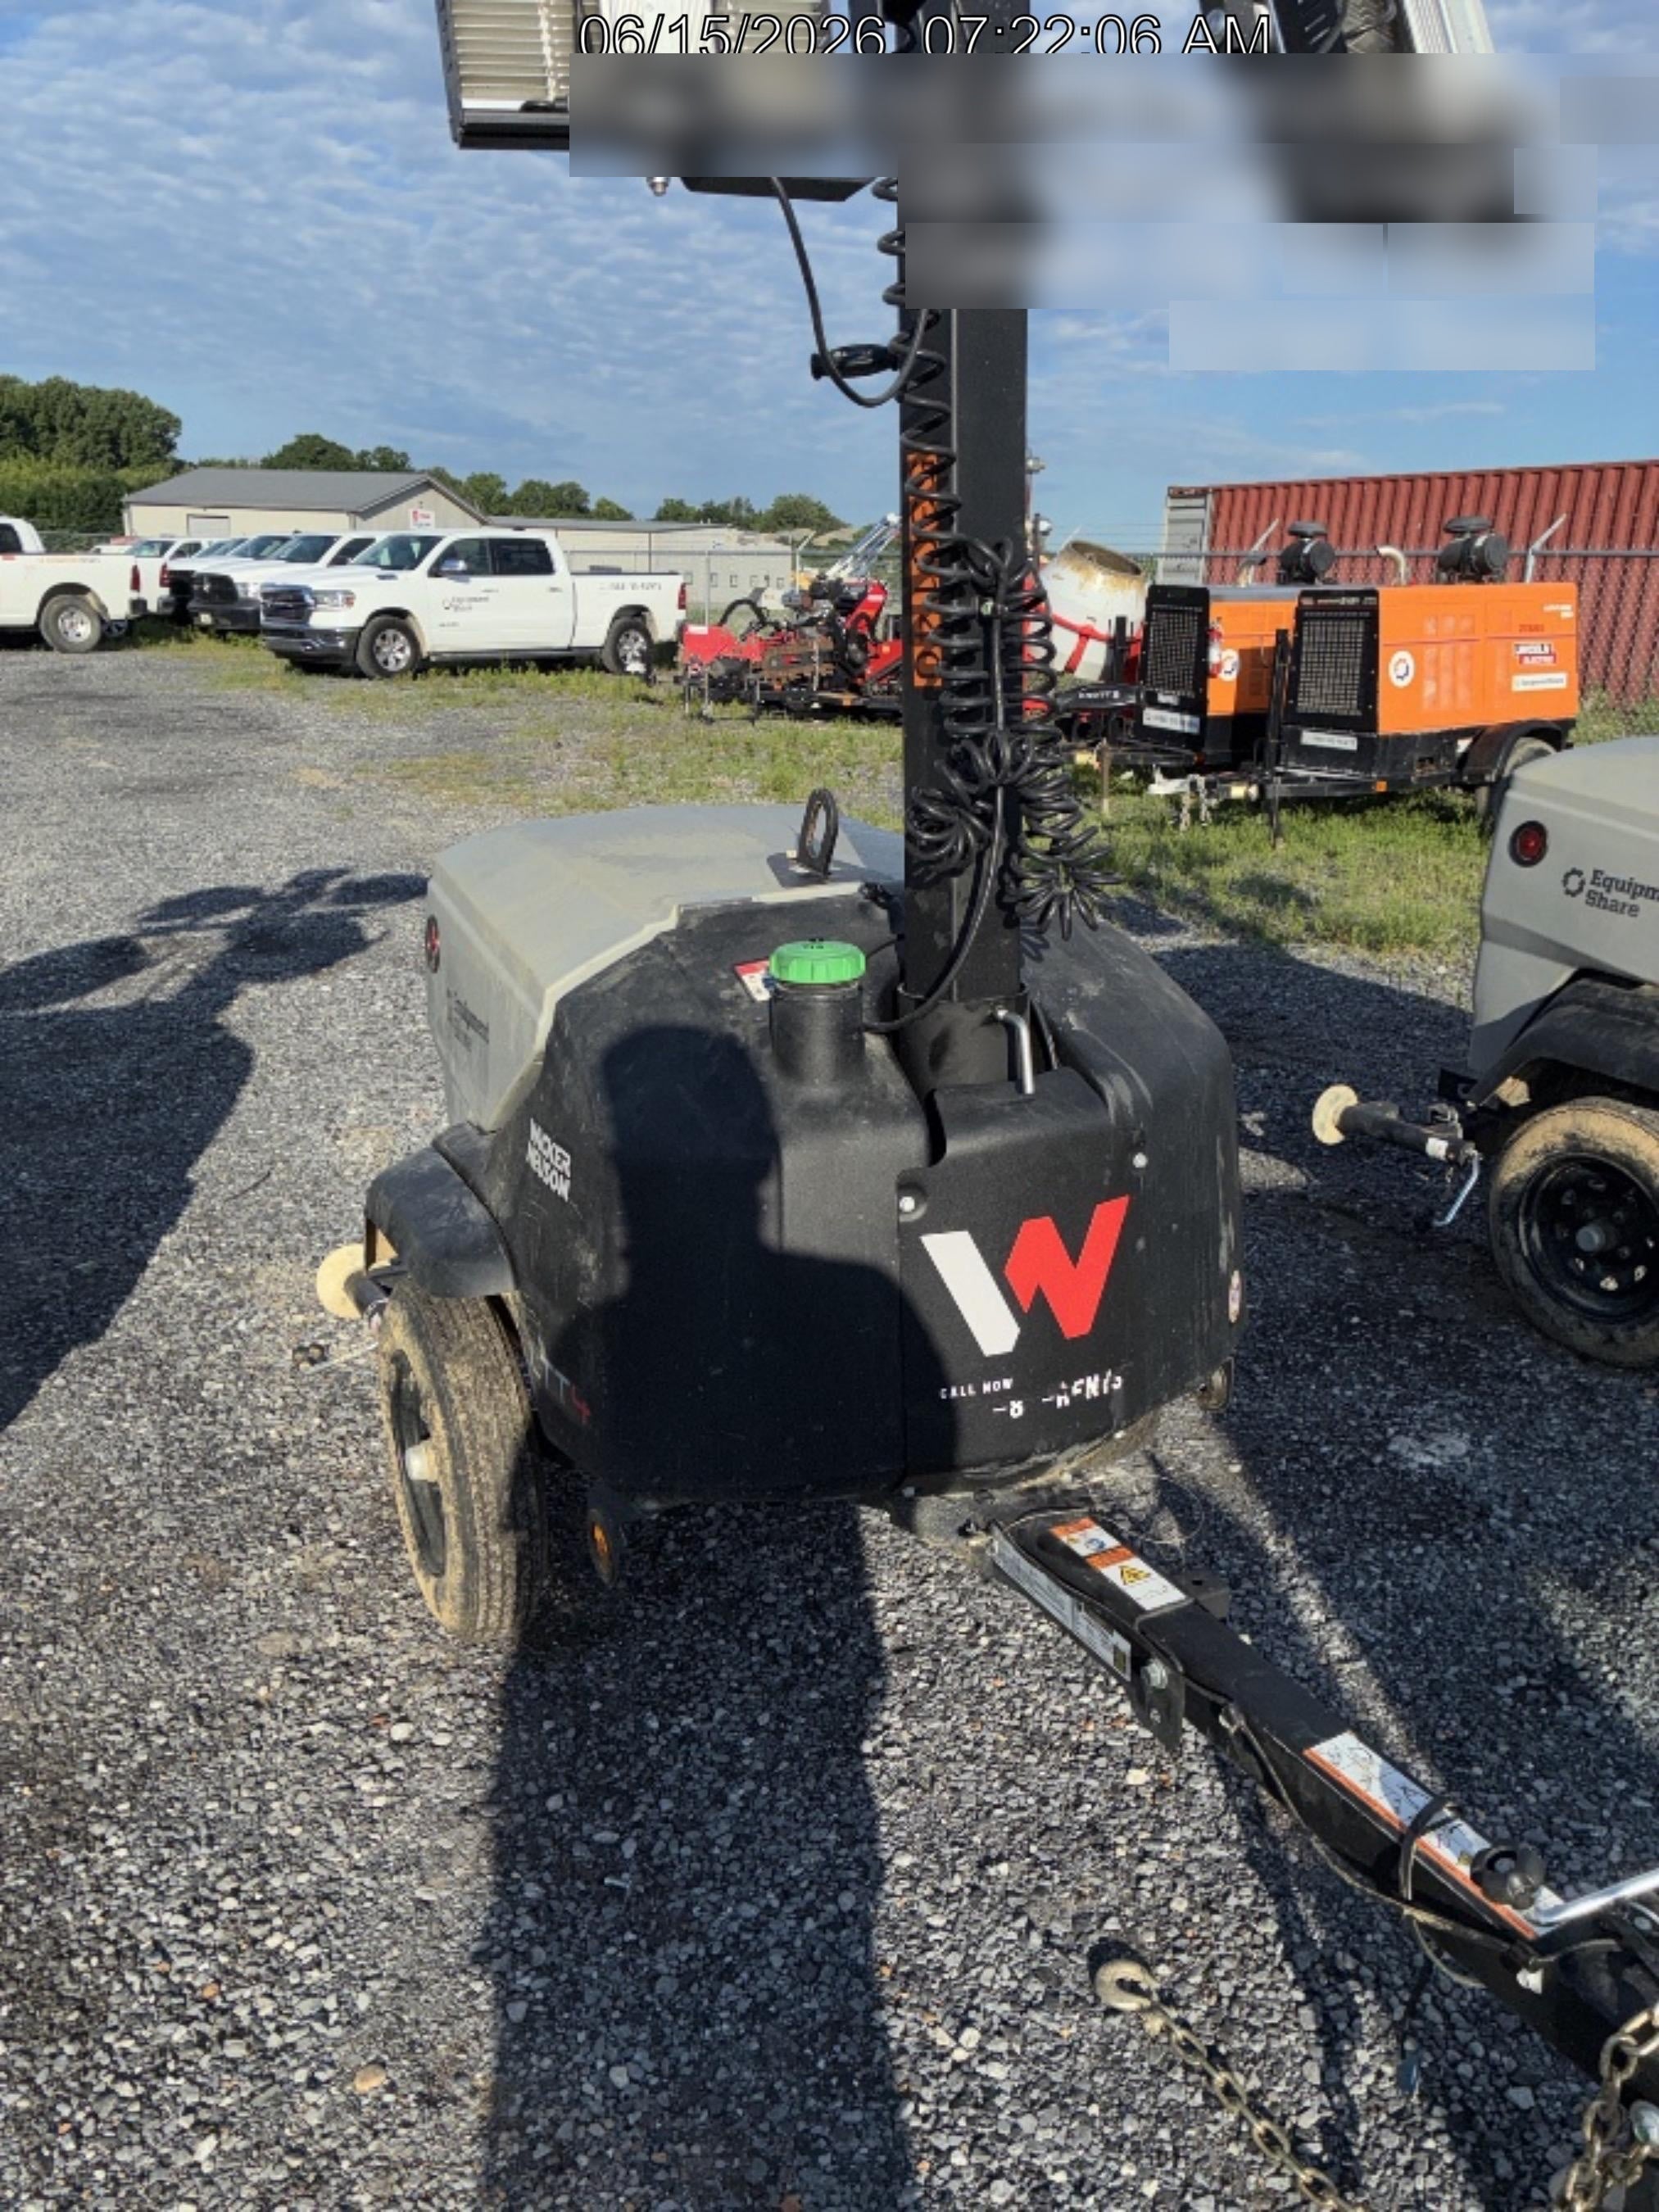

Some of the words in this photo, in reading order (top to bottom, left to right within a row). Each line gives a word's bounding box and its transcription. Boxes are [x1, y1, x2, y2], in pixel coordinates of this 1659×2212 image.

[1585, 889, 1641, 918] Share
[530, 1117, 572, 1178] WACKER
[525, 1140, 571, 1203] NELSON
[940, 1384, 977, 1399] CALL
[983, 1377, 1013, 1394] NOW
